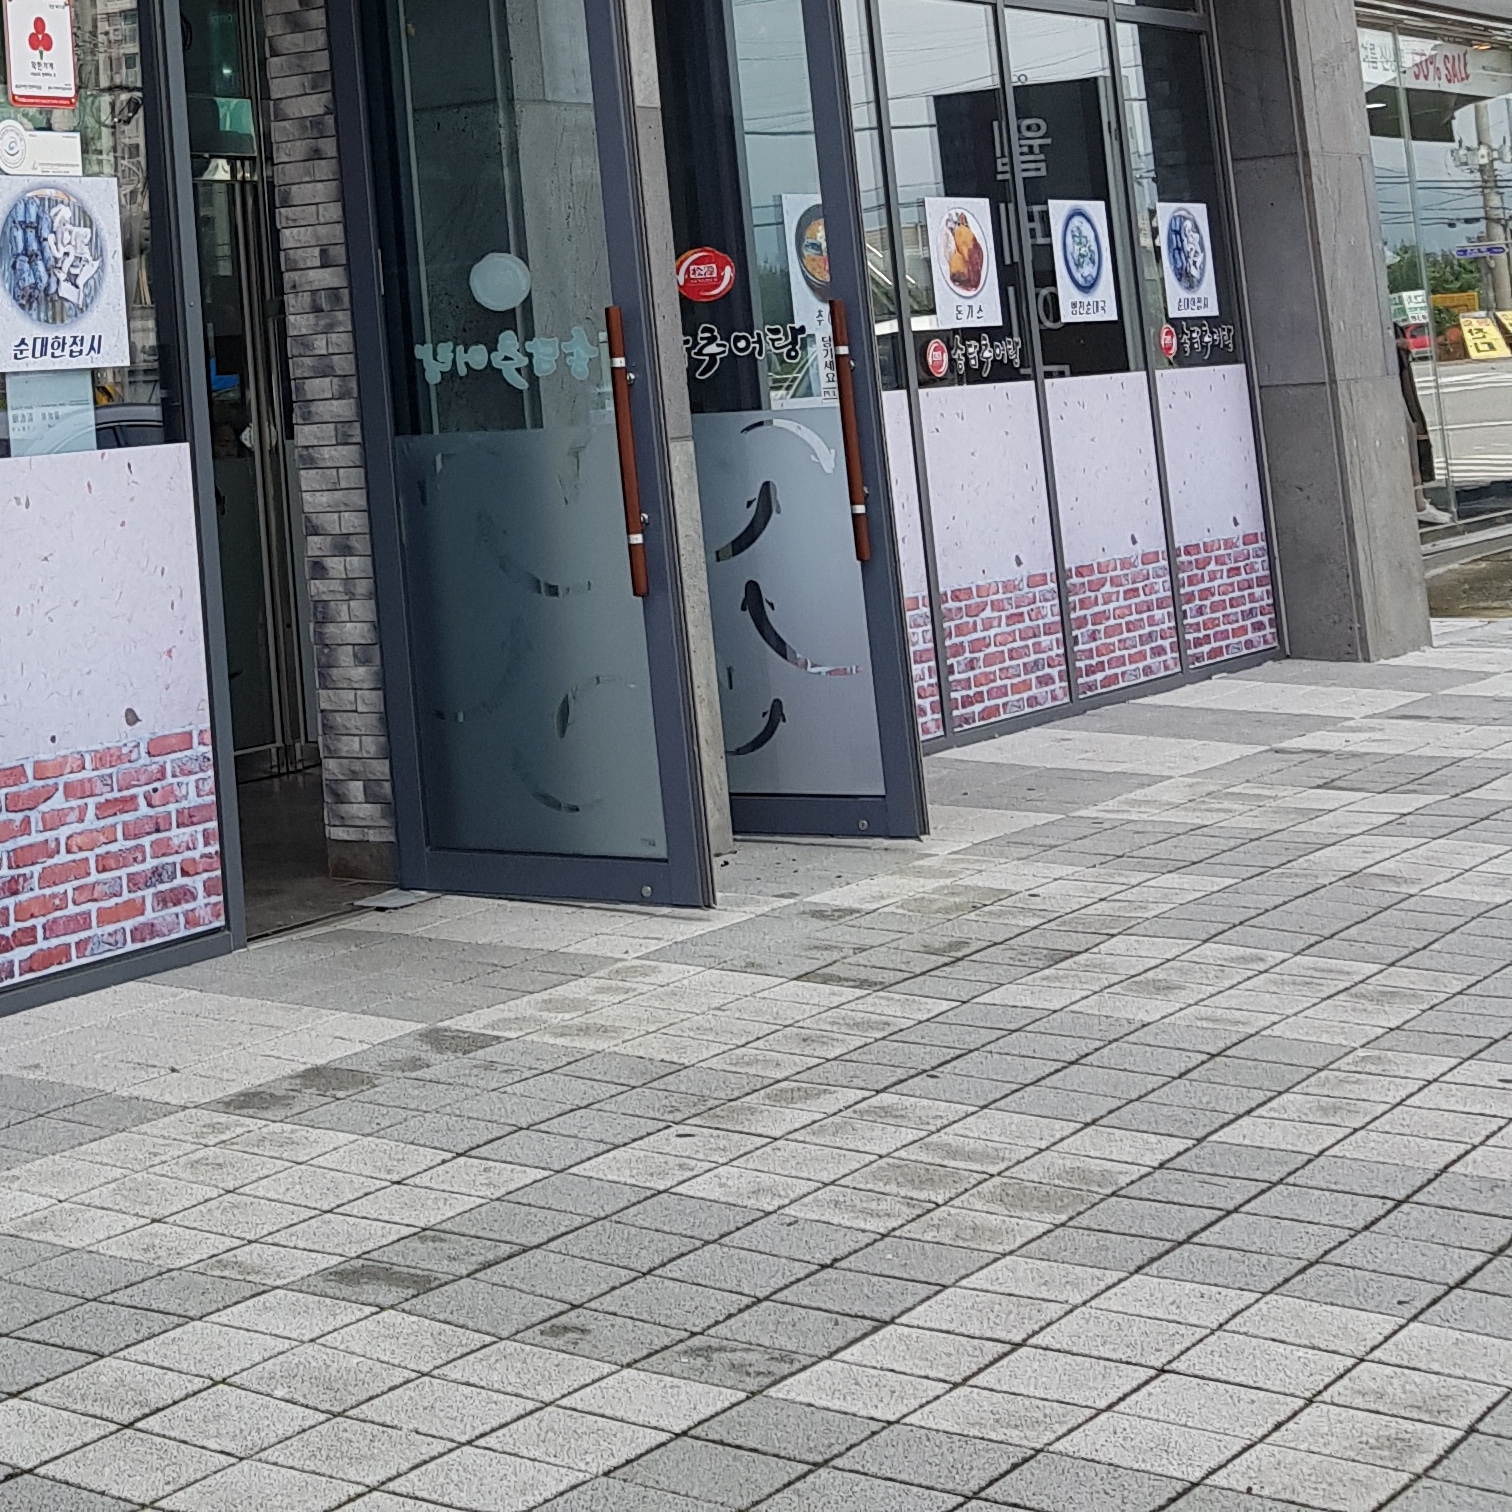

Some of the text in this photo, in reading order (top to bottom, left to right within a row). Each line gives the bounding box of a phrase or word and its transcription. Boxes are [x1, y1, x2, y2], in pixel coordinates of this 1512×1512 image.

[1443, 49, 1471, 84] SALE
[13, 334, 103, 361] 순대한접시
[683, 324, 806, 379] 추어탕
